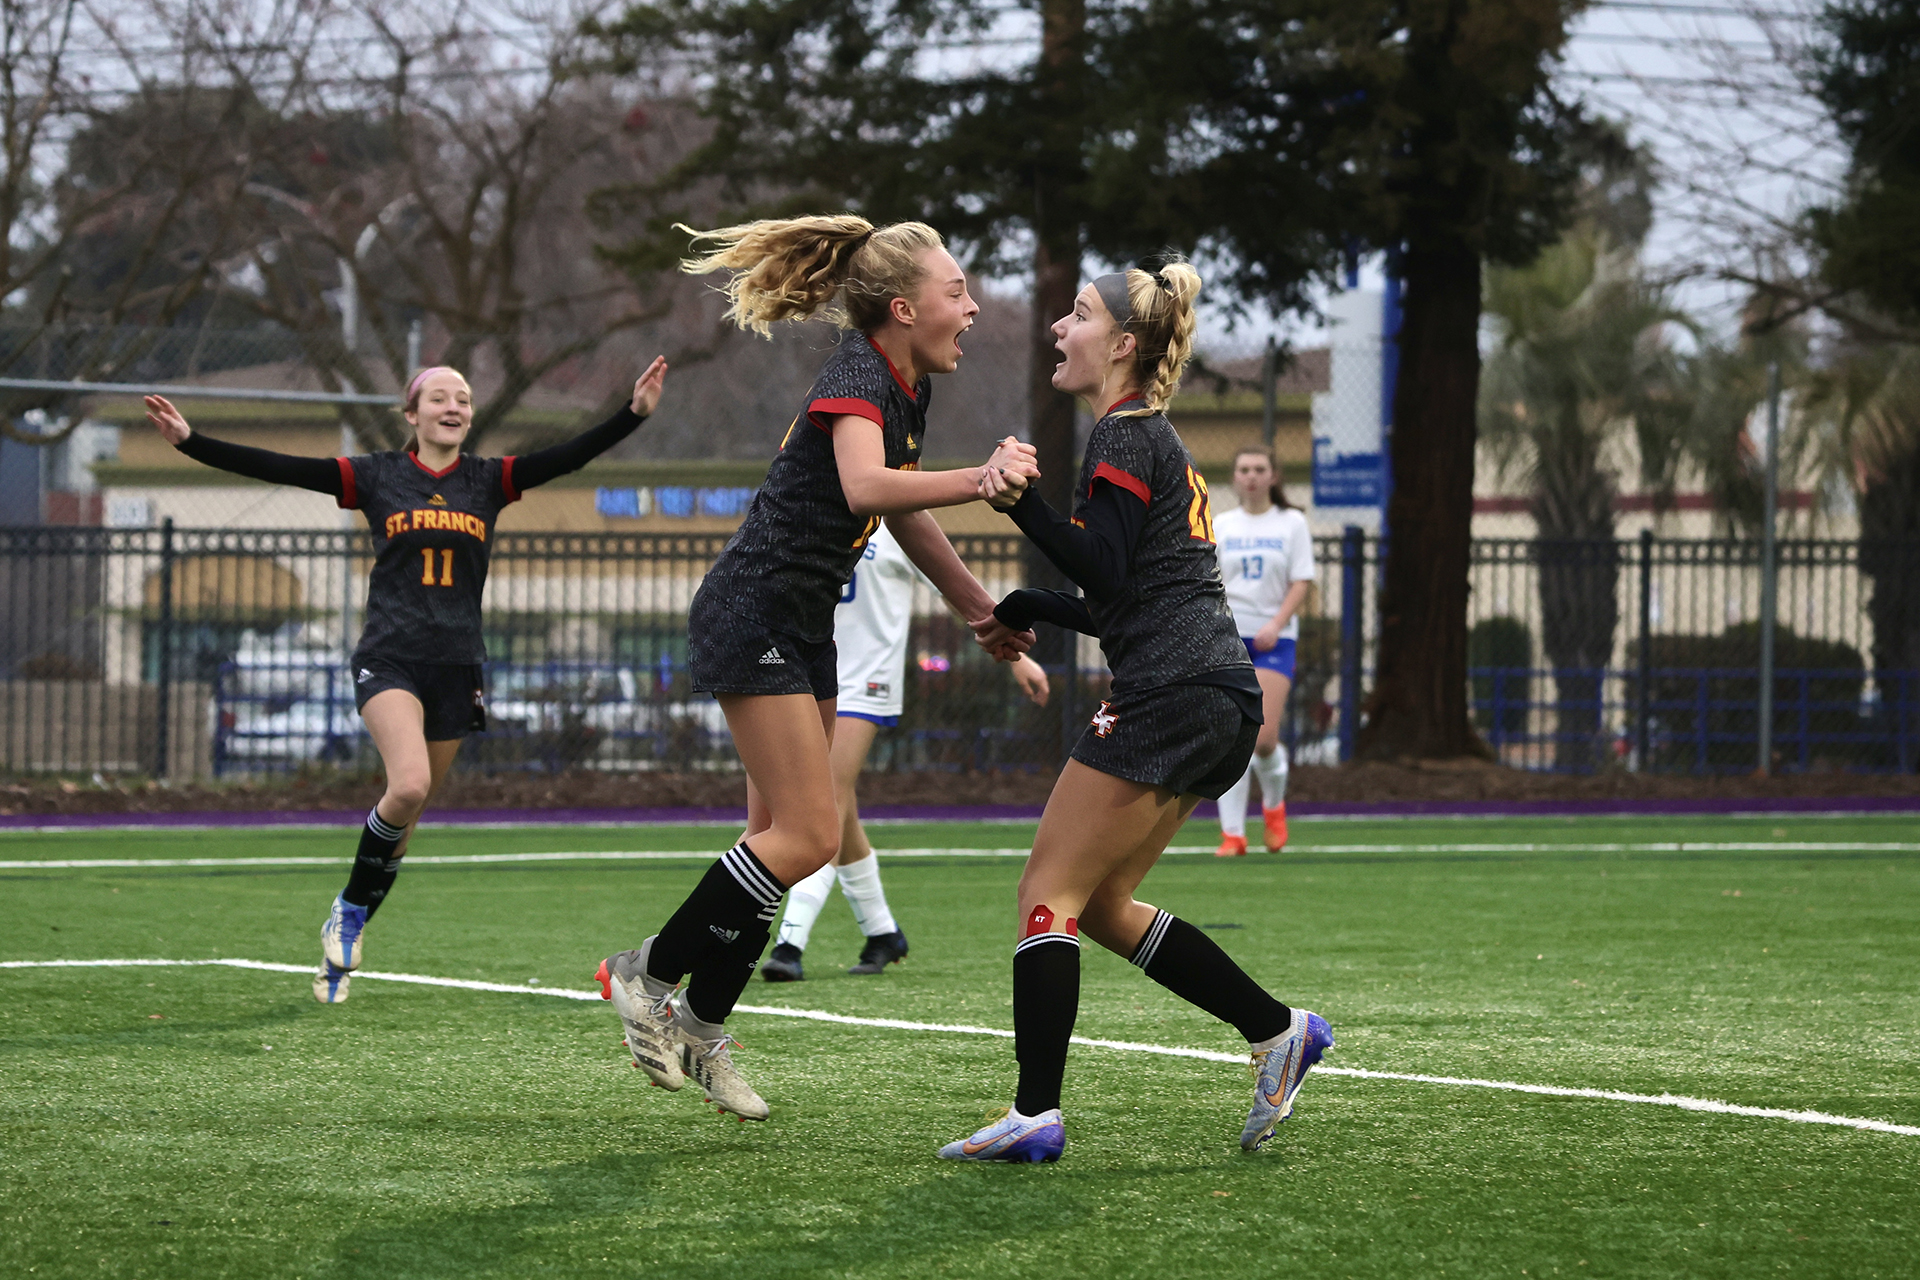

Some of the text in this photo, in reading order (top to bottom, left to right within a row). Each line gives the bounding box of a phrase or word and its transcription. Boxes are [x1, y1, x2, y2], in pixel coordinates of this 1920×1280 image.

[385, 509, 486, 542] ST. FRANCIS
[421, 547, 453, 587] 11
[1242, 555, 1263, 580] 13
[758, 657, 785, 665] adidas
[1034, 915, 1046, 923] KT
